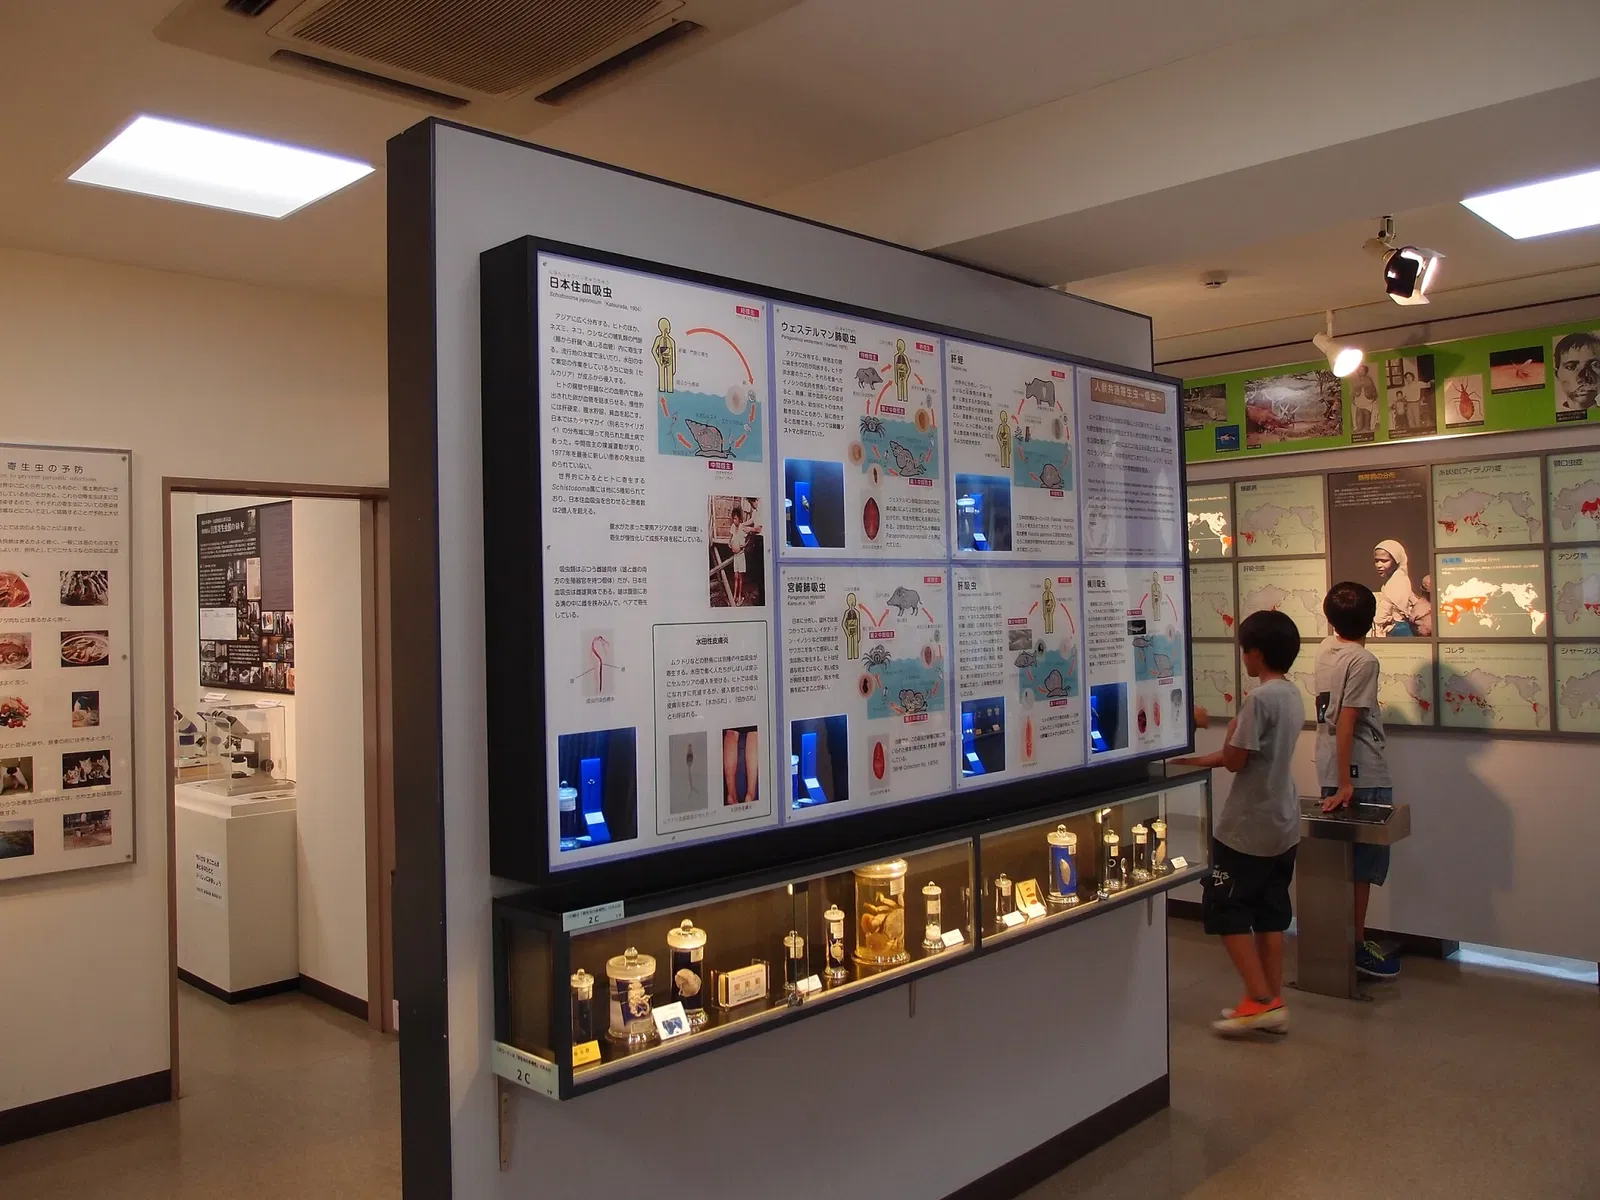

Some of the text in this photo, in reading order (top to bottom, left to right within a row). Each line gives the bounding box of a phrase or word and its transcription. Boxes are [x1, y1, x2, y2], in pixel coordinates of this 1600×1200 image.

[550, 277, 612, 299] 日本住血吸虫
[781, 321, 857, 345] ウェステルマン肺吸虫
[7, 461, 84, 474] 寄生虫の予防
[558, 473, 646, 485] 世界的にみるとヒトに寄生する
[787, 582, 827, 593] 宮崎肺吸虫
[958, 581, 977, 591] 肝吸虫
[555, 611, 580, 619] している。
[695, 636, 729, 646] 水田性皮膚炎
[1444, 646, 1465, 654] コレラ
